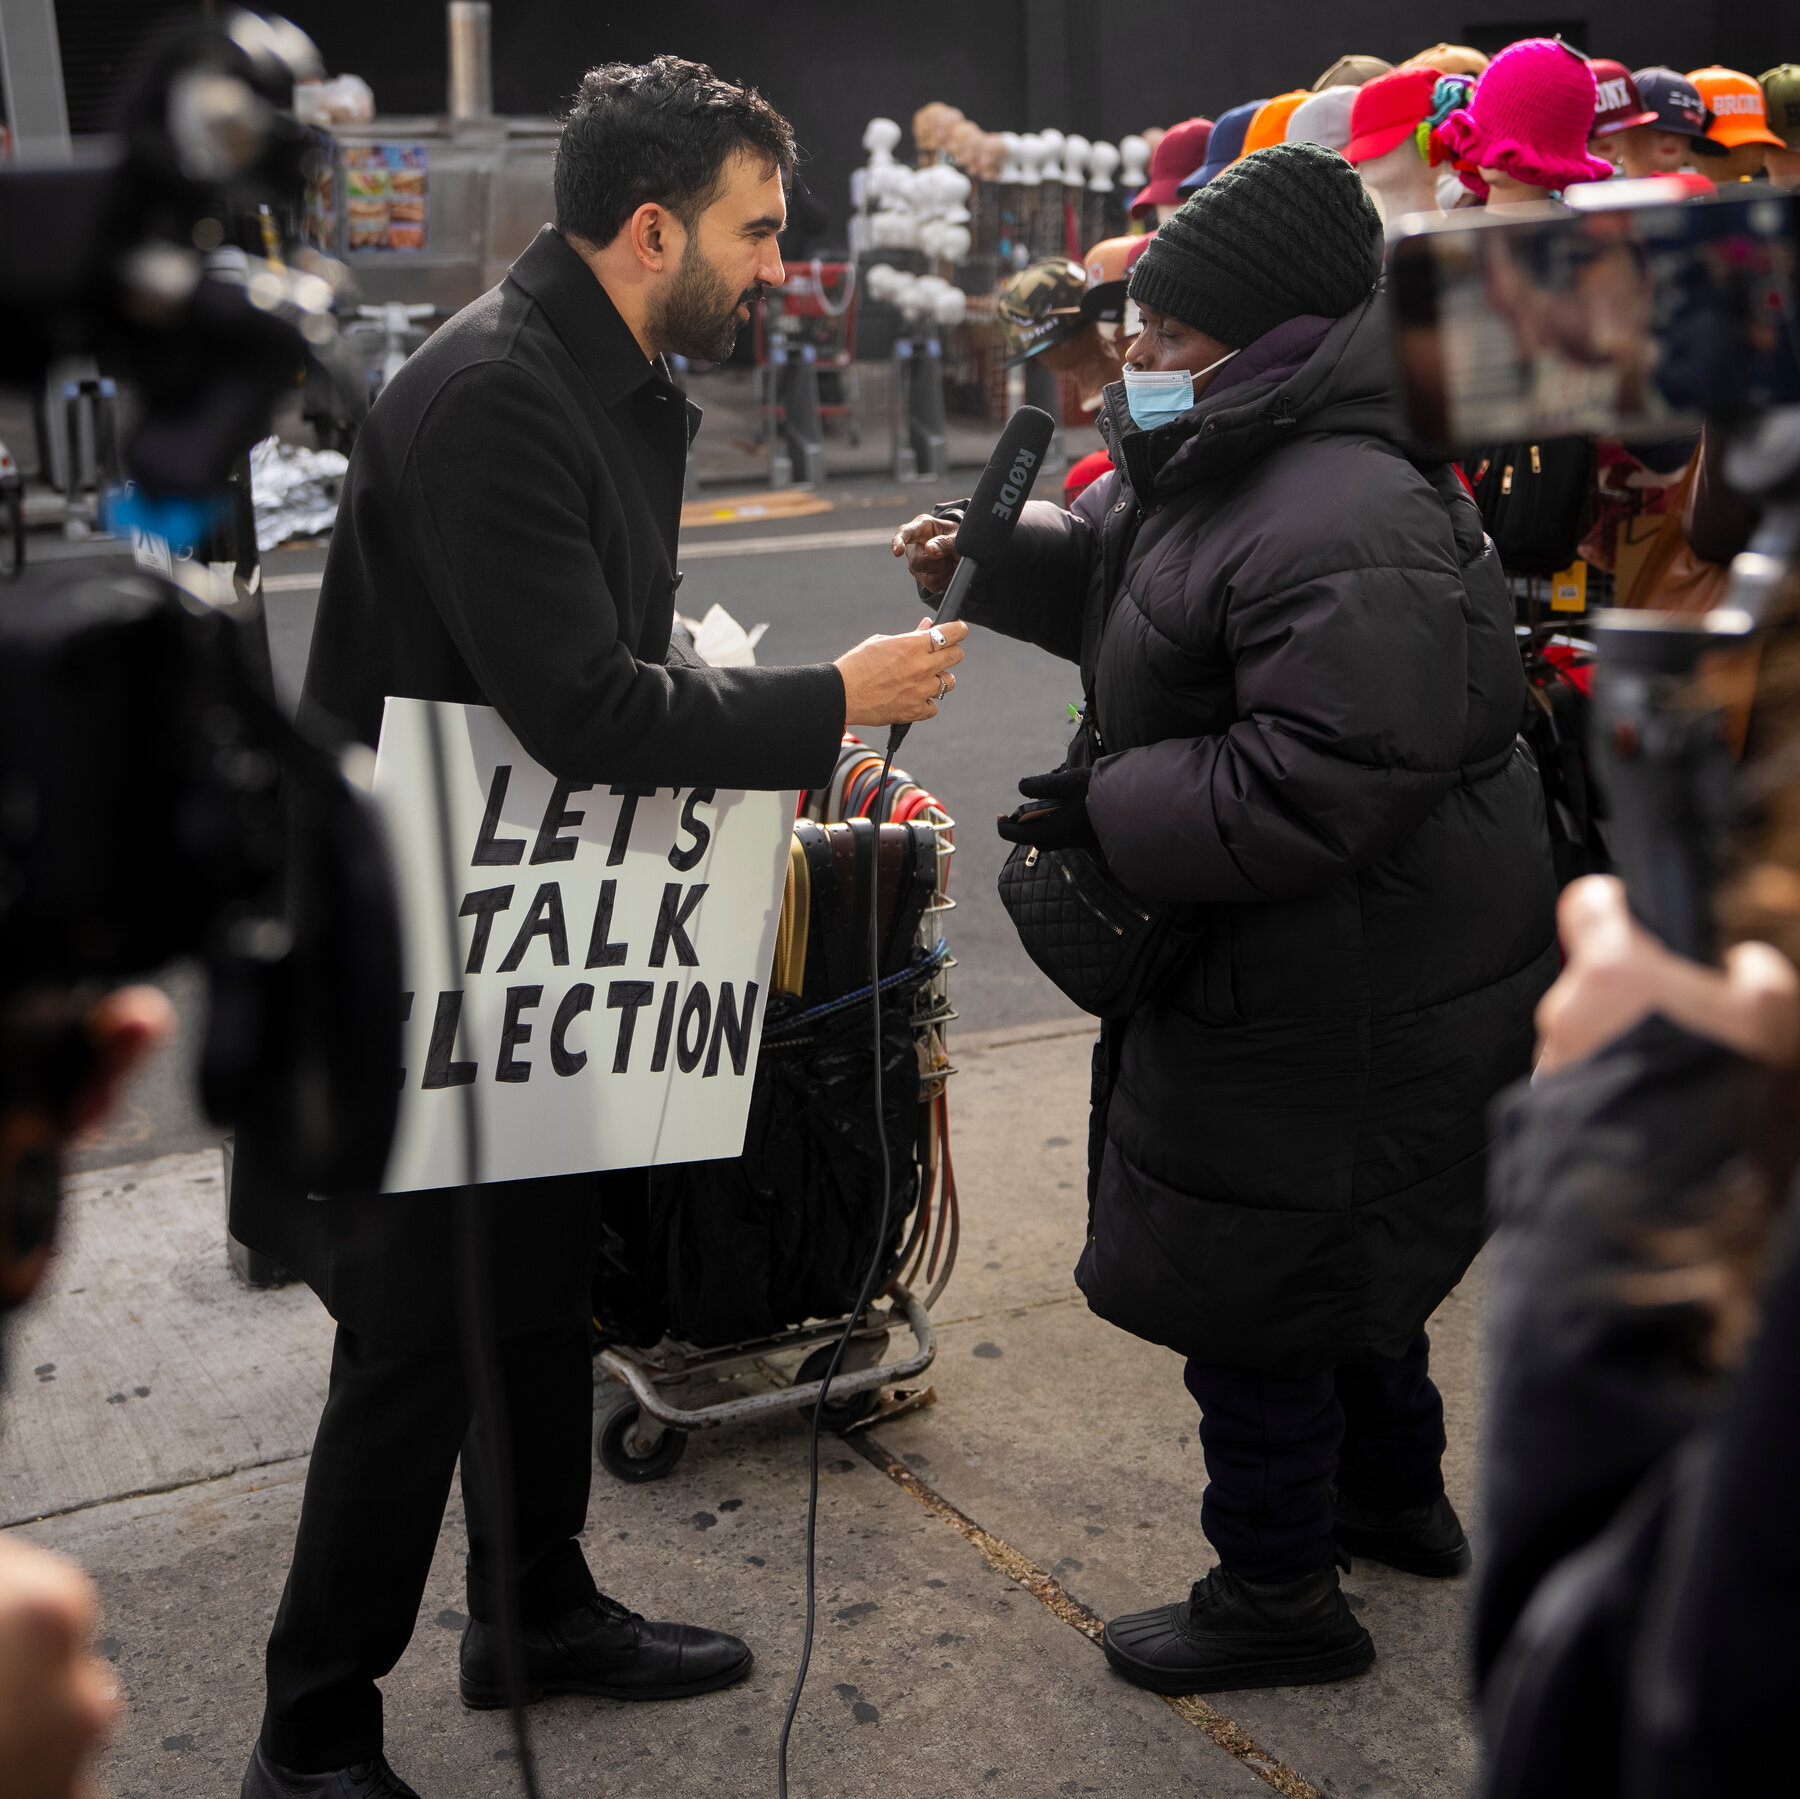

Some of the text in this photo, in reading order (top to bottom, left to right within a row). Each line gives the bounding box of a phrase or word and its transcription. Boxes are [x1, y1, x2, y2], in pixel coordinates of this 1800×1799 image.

[991, 448, 1037, 521] RØDE
[471, 764, 717, 872] LET'S
[458, 878, 710, 975] TALK
